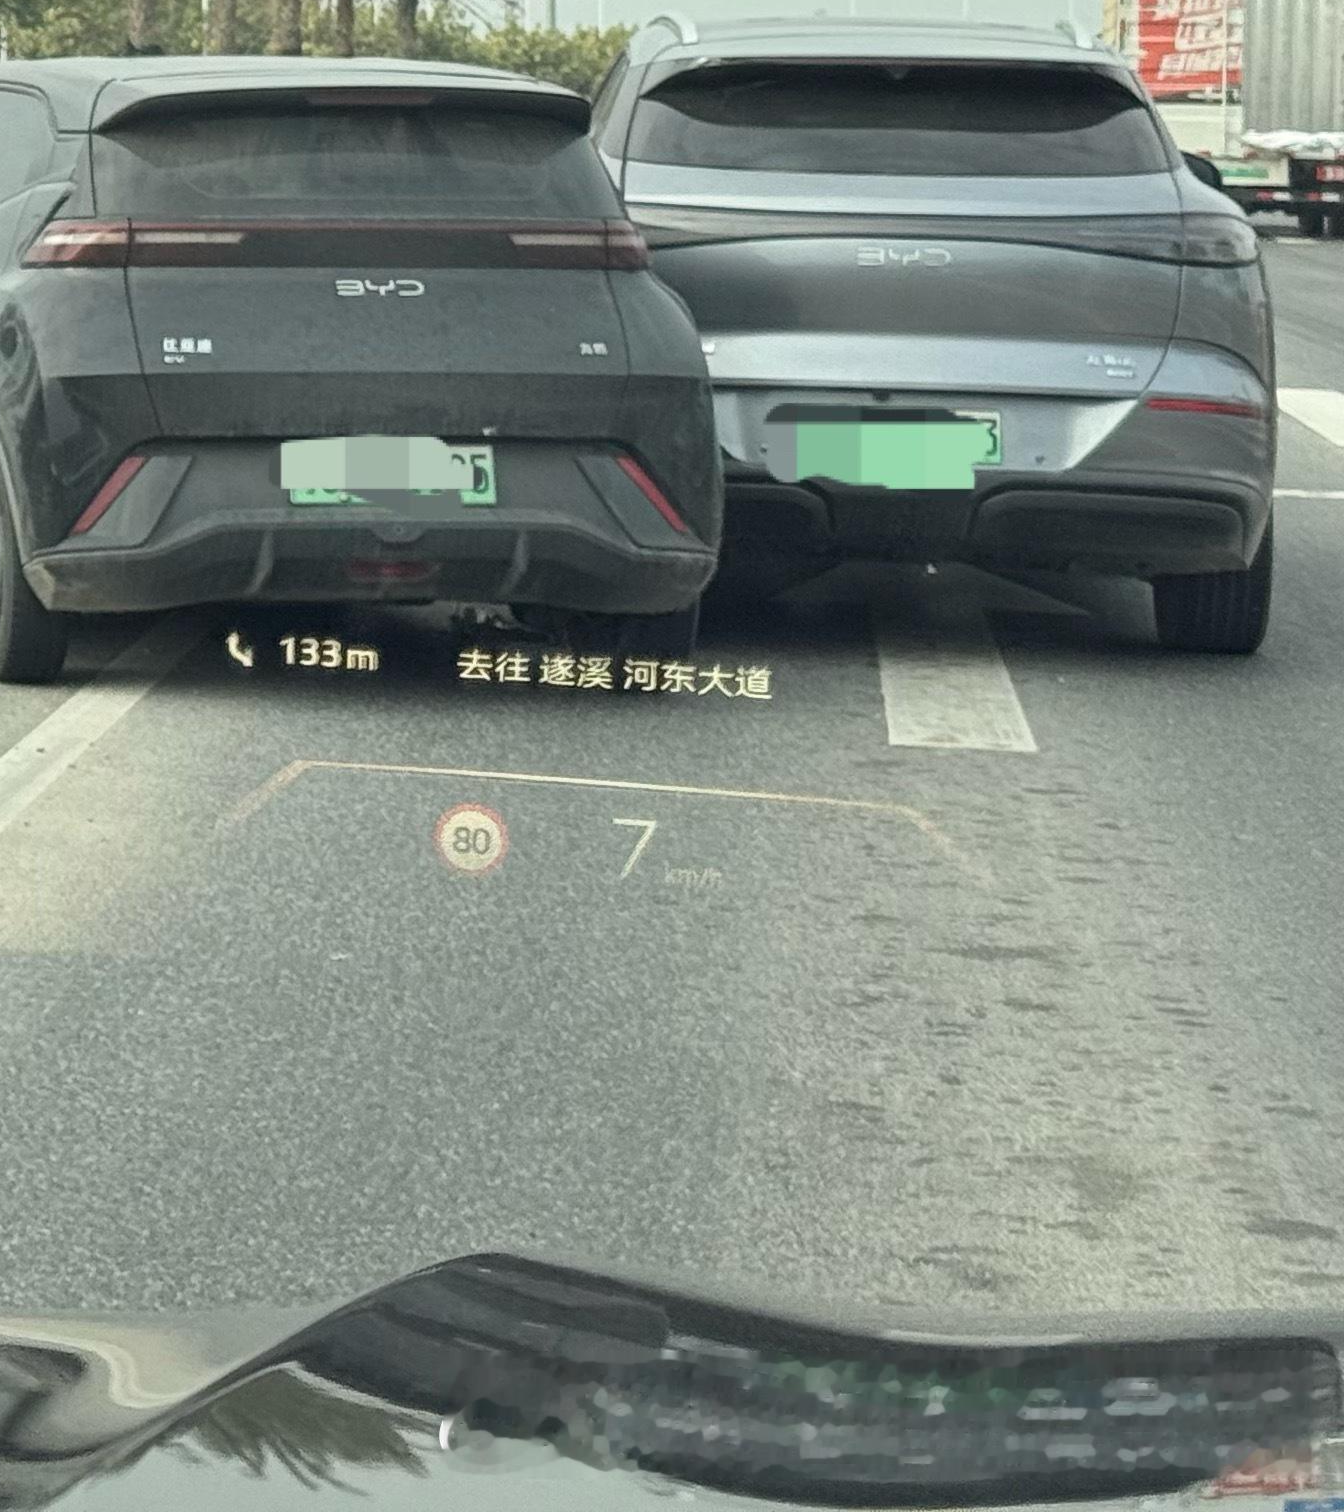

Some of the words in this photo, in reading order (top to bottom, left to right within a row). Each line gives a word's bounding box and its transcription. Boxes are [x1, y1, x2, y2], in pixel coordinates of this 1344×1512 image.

[857, 248, 952, 267] BYD
[335, 279, 425, 297] BYD
[452, 826, 490, 855] 80
[612, 817, 657, 880] 7
